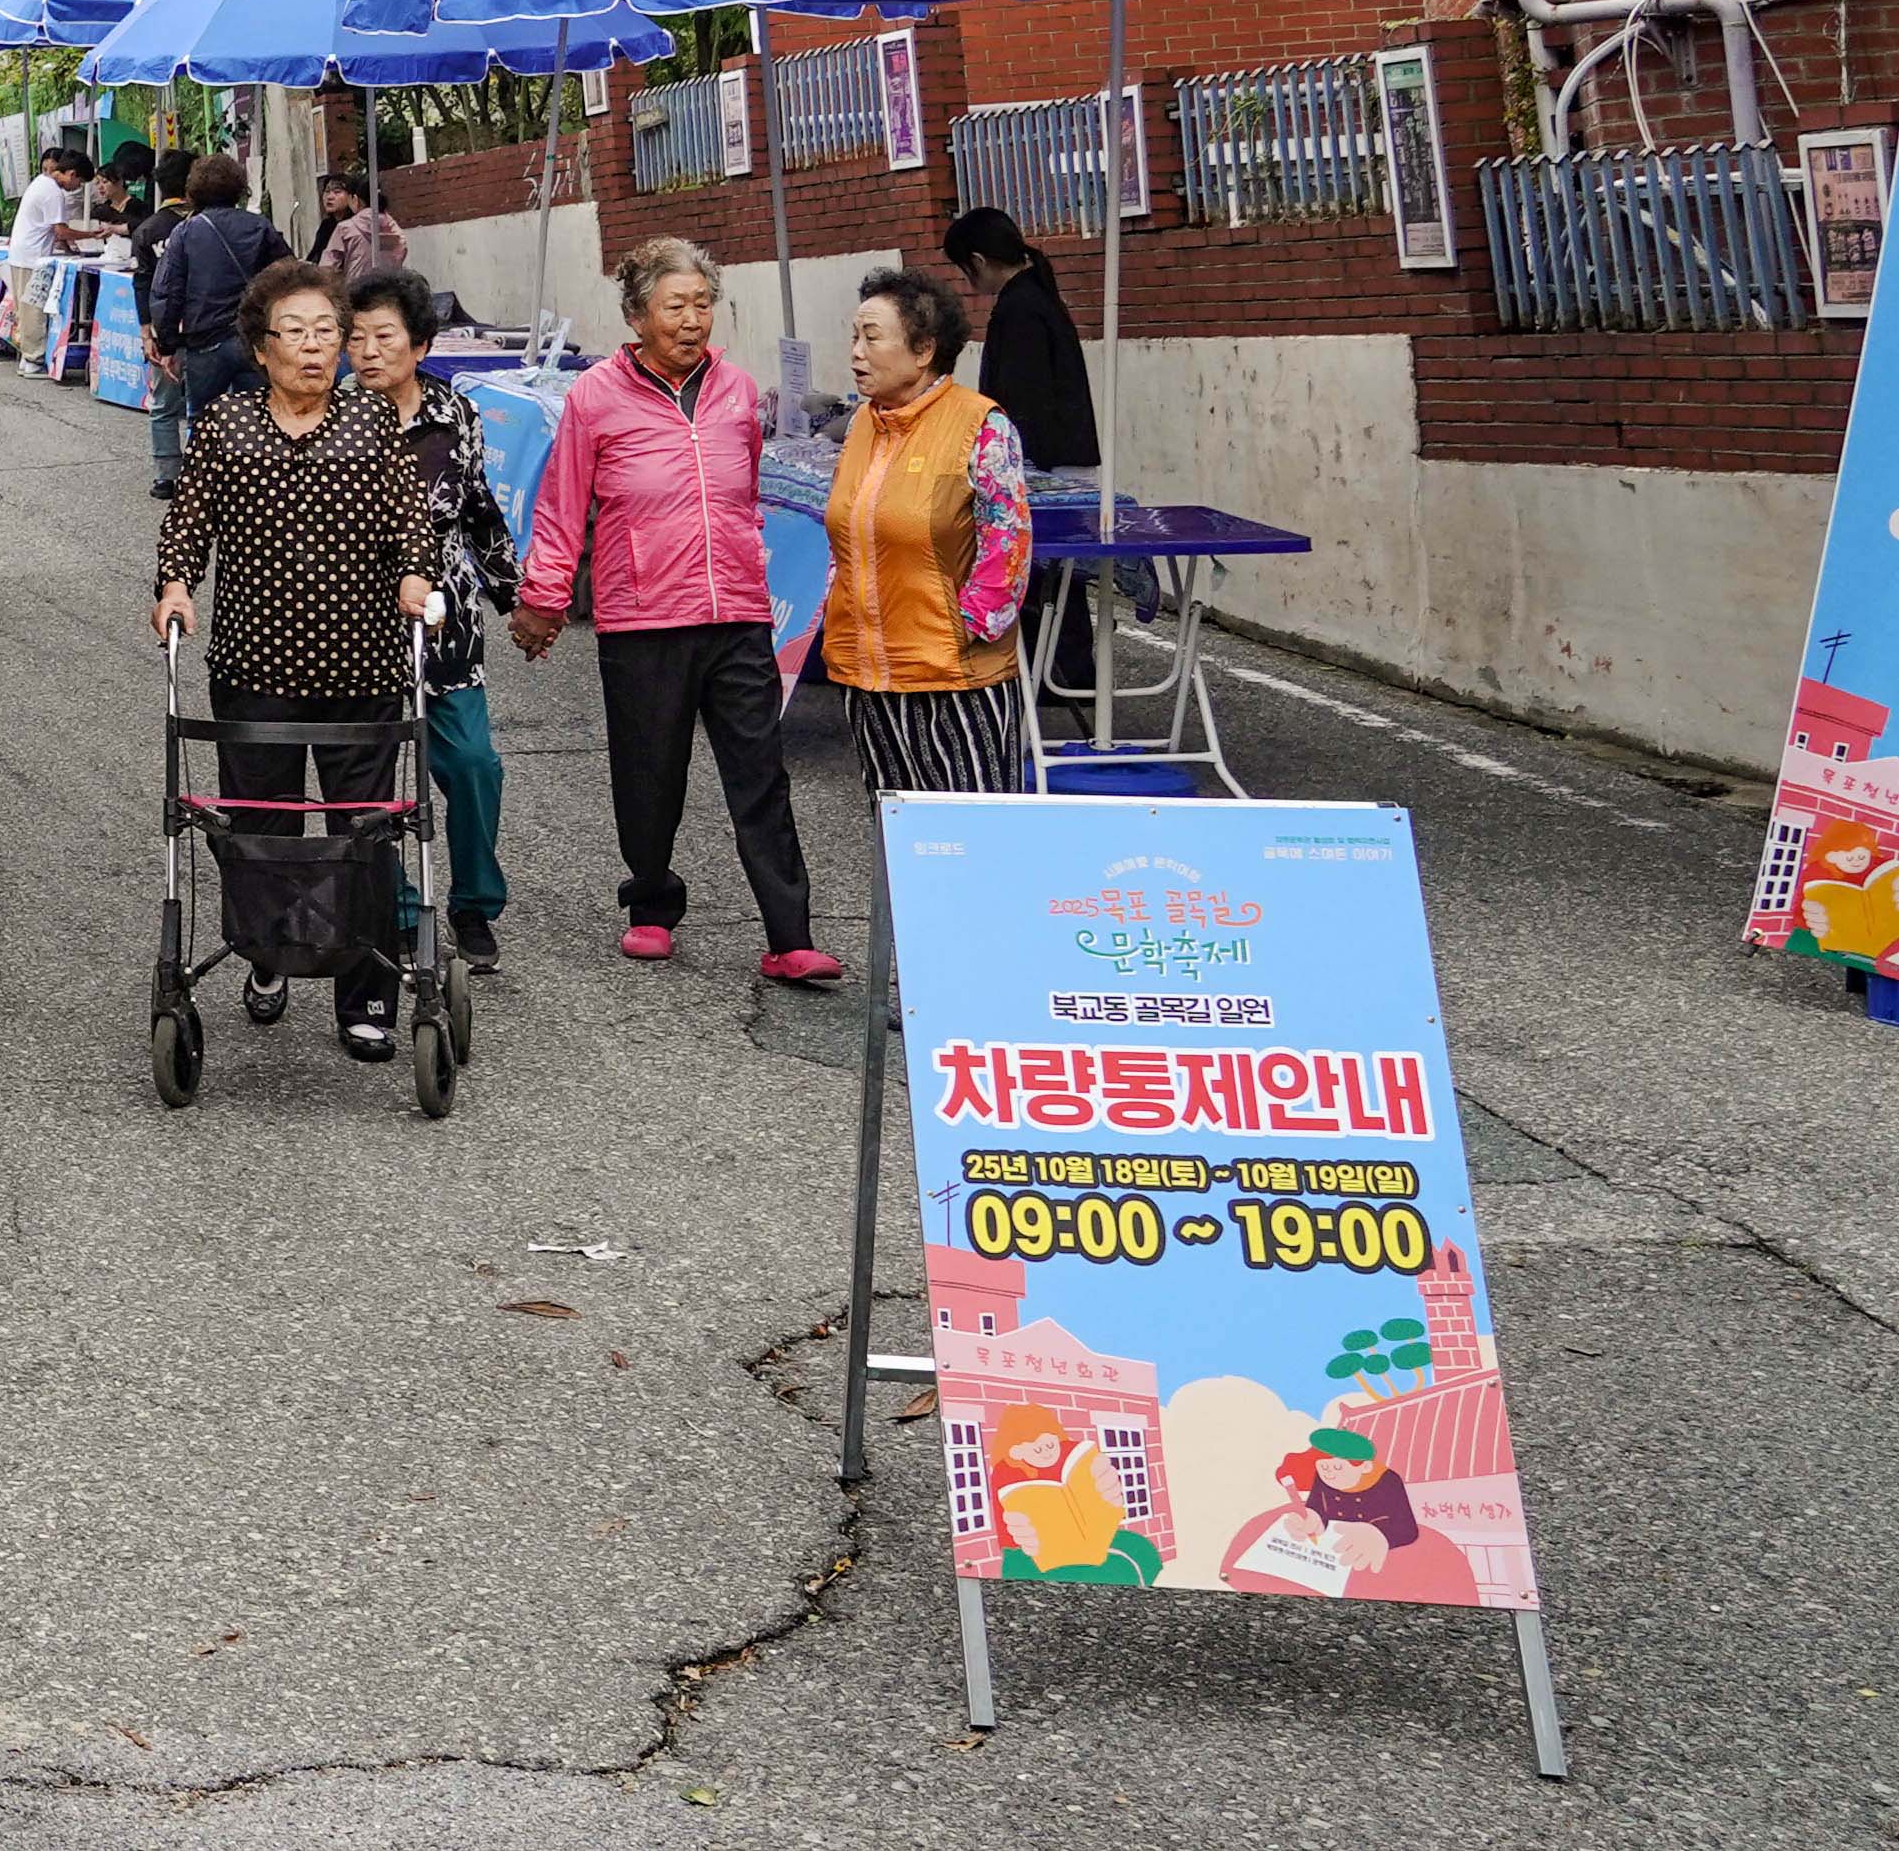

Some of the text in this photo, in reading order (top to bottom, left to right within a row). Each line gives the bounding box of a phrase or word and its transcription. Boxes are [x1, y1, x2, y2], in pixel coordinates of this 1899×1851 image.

[1164, 889, 1263, 928] 골목길
[1078, 928, 1251, 981] 문학축제
[1052, 994, 1272, 1027] 북교동 골목길 일원
[939, 1045, 1428, 1135] 차량통제안내
[965, 1153, 1028, 1181] 25년
[1035, 1155, 1094, 1184] 10월
[1101, 1157, 1207, 1189] 18일(토)
[1238, 1162, 1296, 1192] 10월
[1304, 1164, 1414, 1196] 19일(일)
[972, 1194, 1159, 1260] 09:00
[1233, 1204, 1424, 1270] 19:00
[976, 1346, 1119, 1382] 목포청년회관
